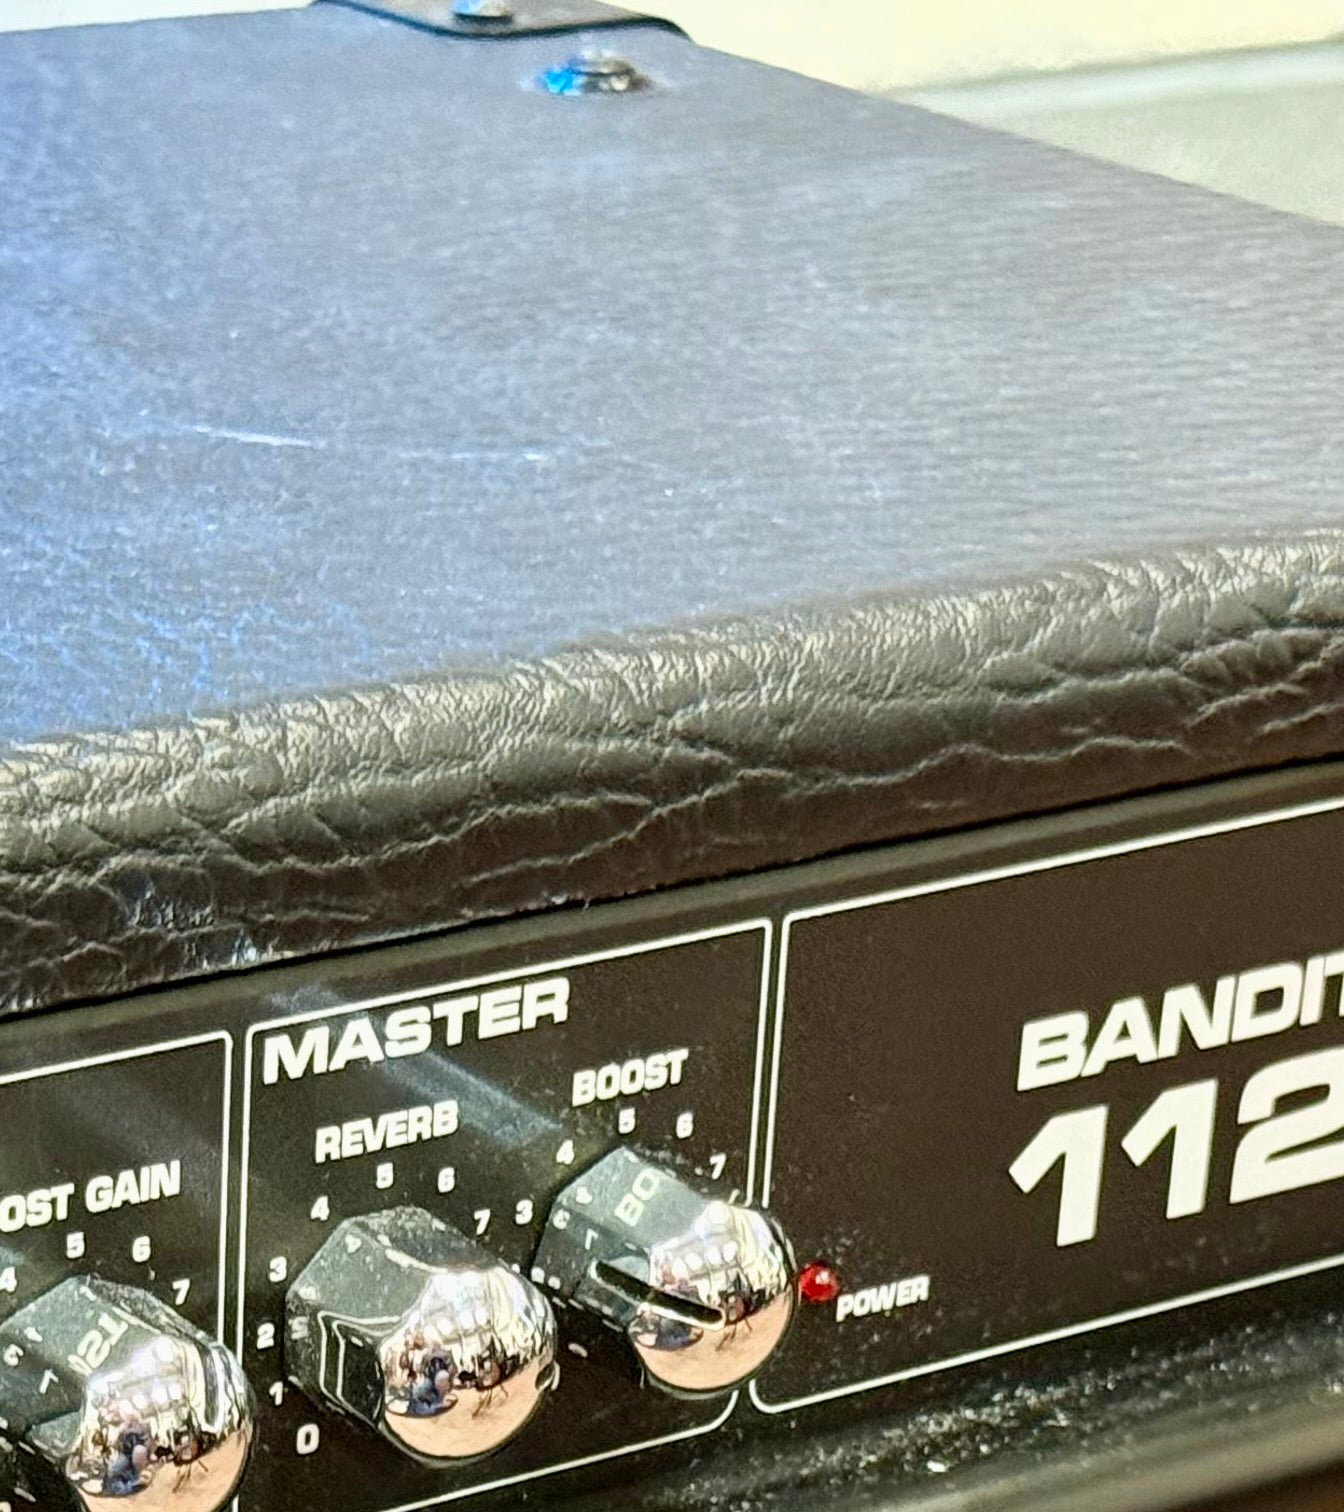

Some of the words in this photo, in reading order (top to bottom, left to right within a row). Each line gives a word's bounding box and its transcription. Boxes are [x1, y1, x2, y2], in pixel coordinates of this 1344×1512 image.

[262, 976, 570, 1085] MASTER
[571, 1048, 689, 1106] BOOST
[315, 1100, 459, 1164] REVERB
[376, 1163, 394, 1189] 5
[437, 1166, 455, 1192] 6
[515, 1199, 533, 1225] 3
[556, 1139, 575, 1165] 4
[618, 1107, 636, 1134] 5
[676, 1112, 693, 1138] 6
[709, 1152, 727, 1180] 7
[84, 1158, 181, 1213] GAIN
[310, 1195, 329, 1221] 4
[473, 1208, 491, 1235] 7
[66, 1231, 85, 1258] 5
[131, 1235, 152, 1263] 6
[172, 1278, 191, 1306] 7
[269, 1256, 287, 1283] 3
[835, 1274, 930, 1323] POWER
[256, 1322, 275, 1350] 2
[268, 1381, 284, 1406] 1
[296, 1423, 319, 1454] 0
